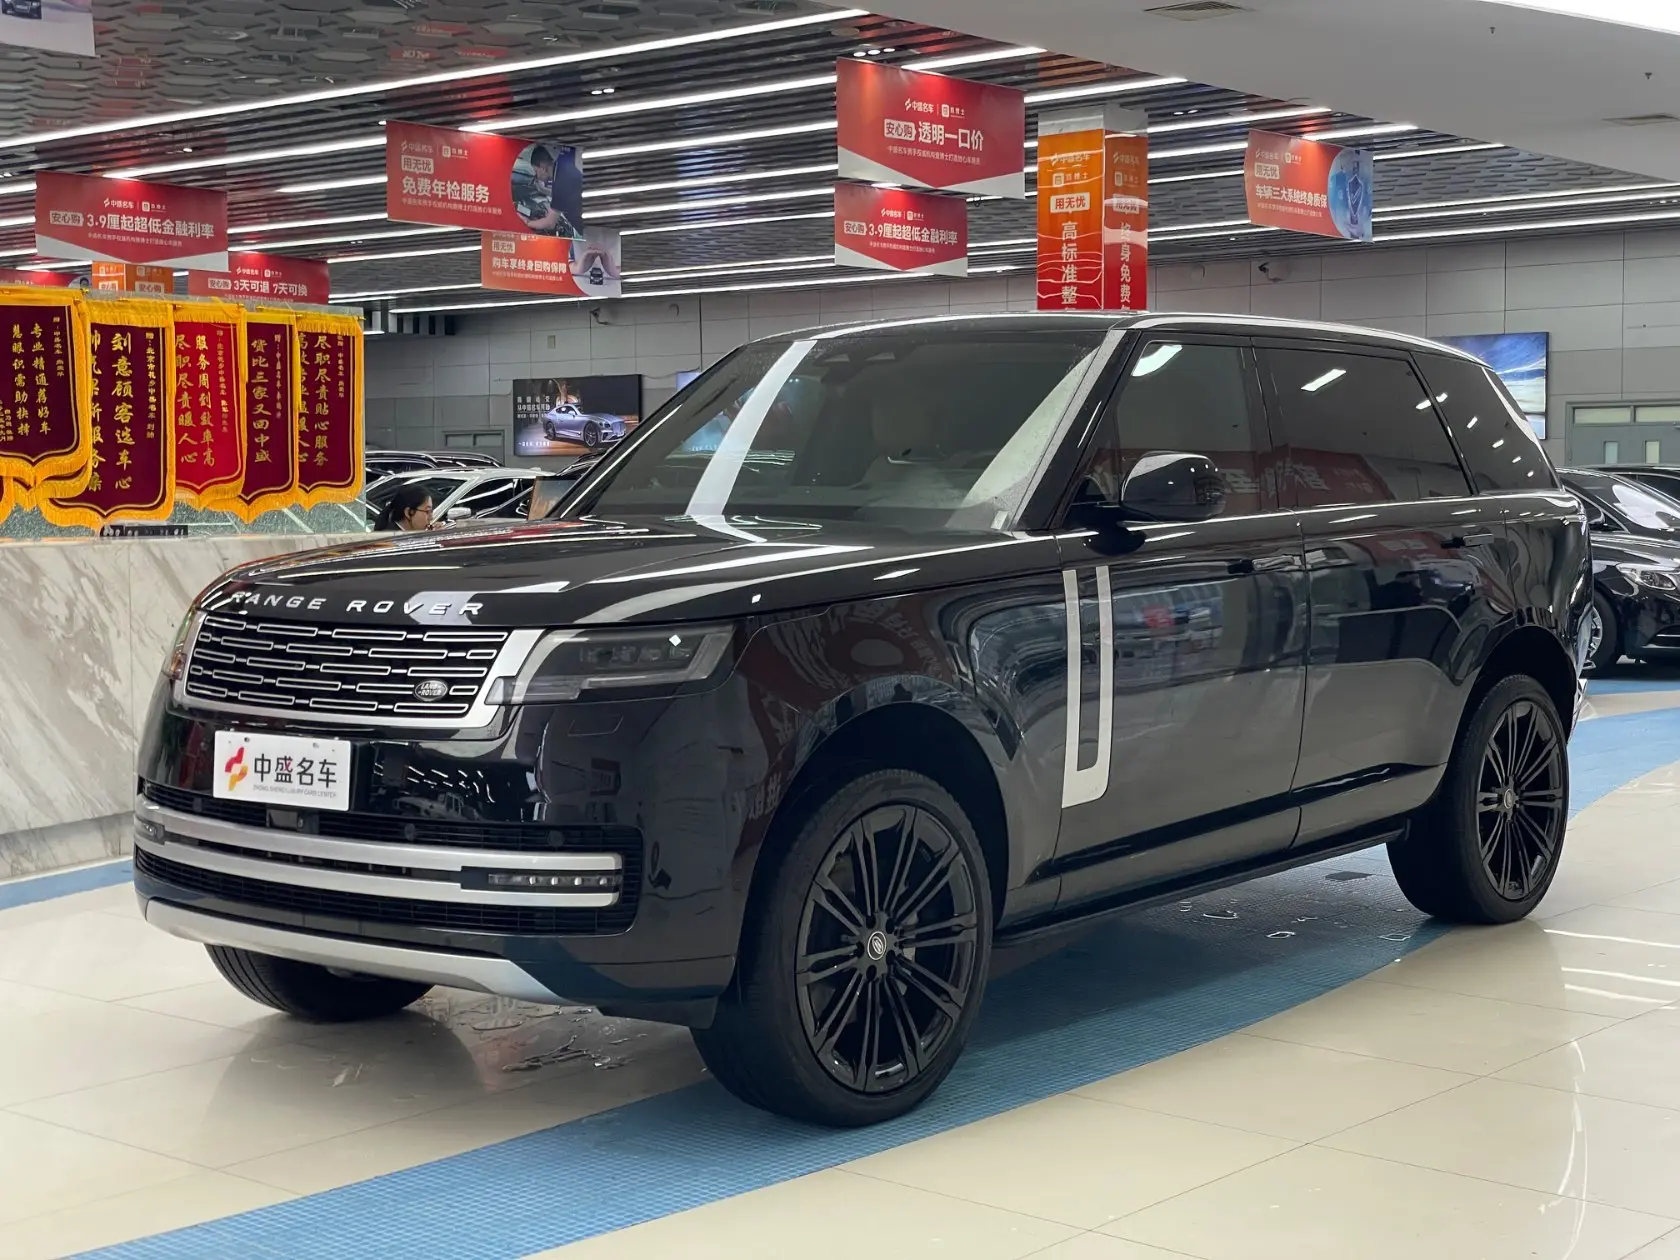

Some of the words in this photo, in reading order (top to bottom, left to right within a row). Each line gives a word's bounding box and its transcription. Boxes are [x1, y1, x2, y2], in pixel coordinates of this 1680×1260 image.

[911, 101, 934, 114] 中盛名车
[886, 122, 913, 138] 安心购
[918, 121, 984, 151] 透明一口价
[403, 157, 432, 172] 用无忧
[1256, 164, 1279, 178] 用无忧
[402, 176, 490, 203] 免费年检服务
[1055, 195, 1086, 209] 用无忧
[1255, 184, 1328, 208] 车辆三大系统终身质保
[52, 213, 81, 225] 安心购
[87, 214, 214, 239] 3.9厘起超低金融利率
[845, 222, 865, 233] 安心购
[869, 222, 958, 245] 3.9厘起超低金融利率
[492, 257, 567, 274] 购车享终身回购保障
[1061, 220, 1078, 310] 高标准整
[1120, 221, 1132, 310] 终身免费
[138, 284, 162, 294] 安心购
[233, 280, 270, 294] 3天可退
[273, 283, 308, 297] 7天可换
[31, 323, 51, 436] 专业精通荐好车
[175, 334, 198, 463] 尽职尽责暖人心
[313, 335, 332, 466] 尽职尽责贴心服务
[229, 591, 326, 611] RANGE
[347, 600, 483, 616] ROVER
[254, 753, 337, 789] 中盛名车
